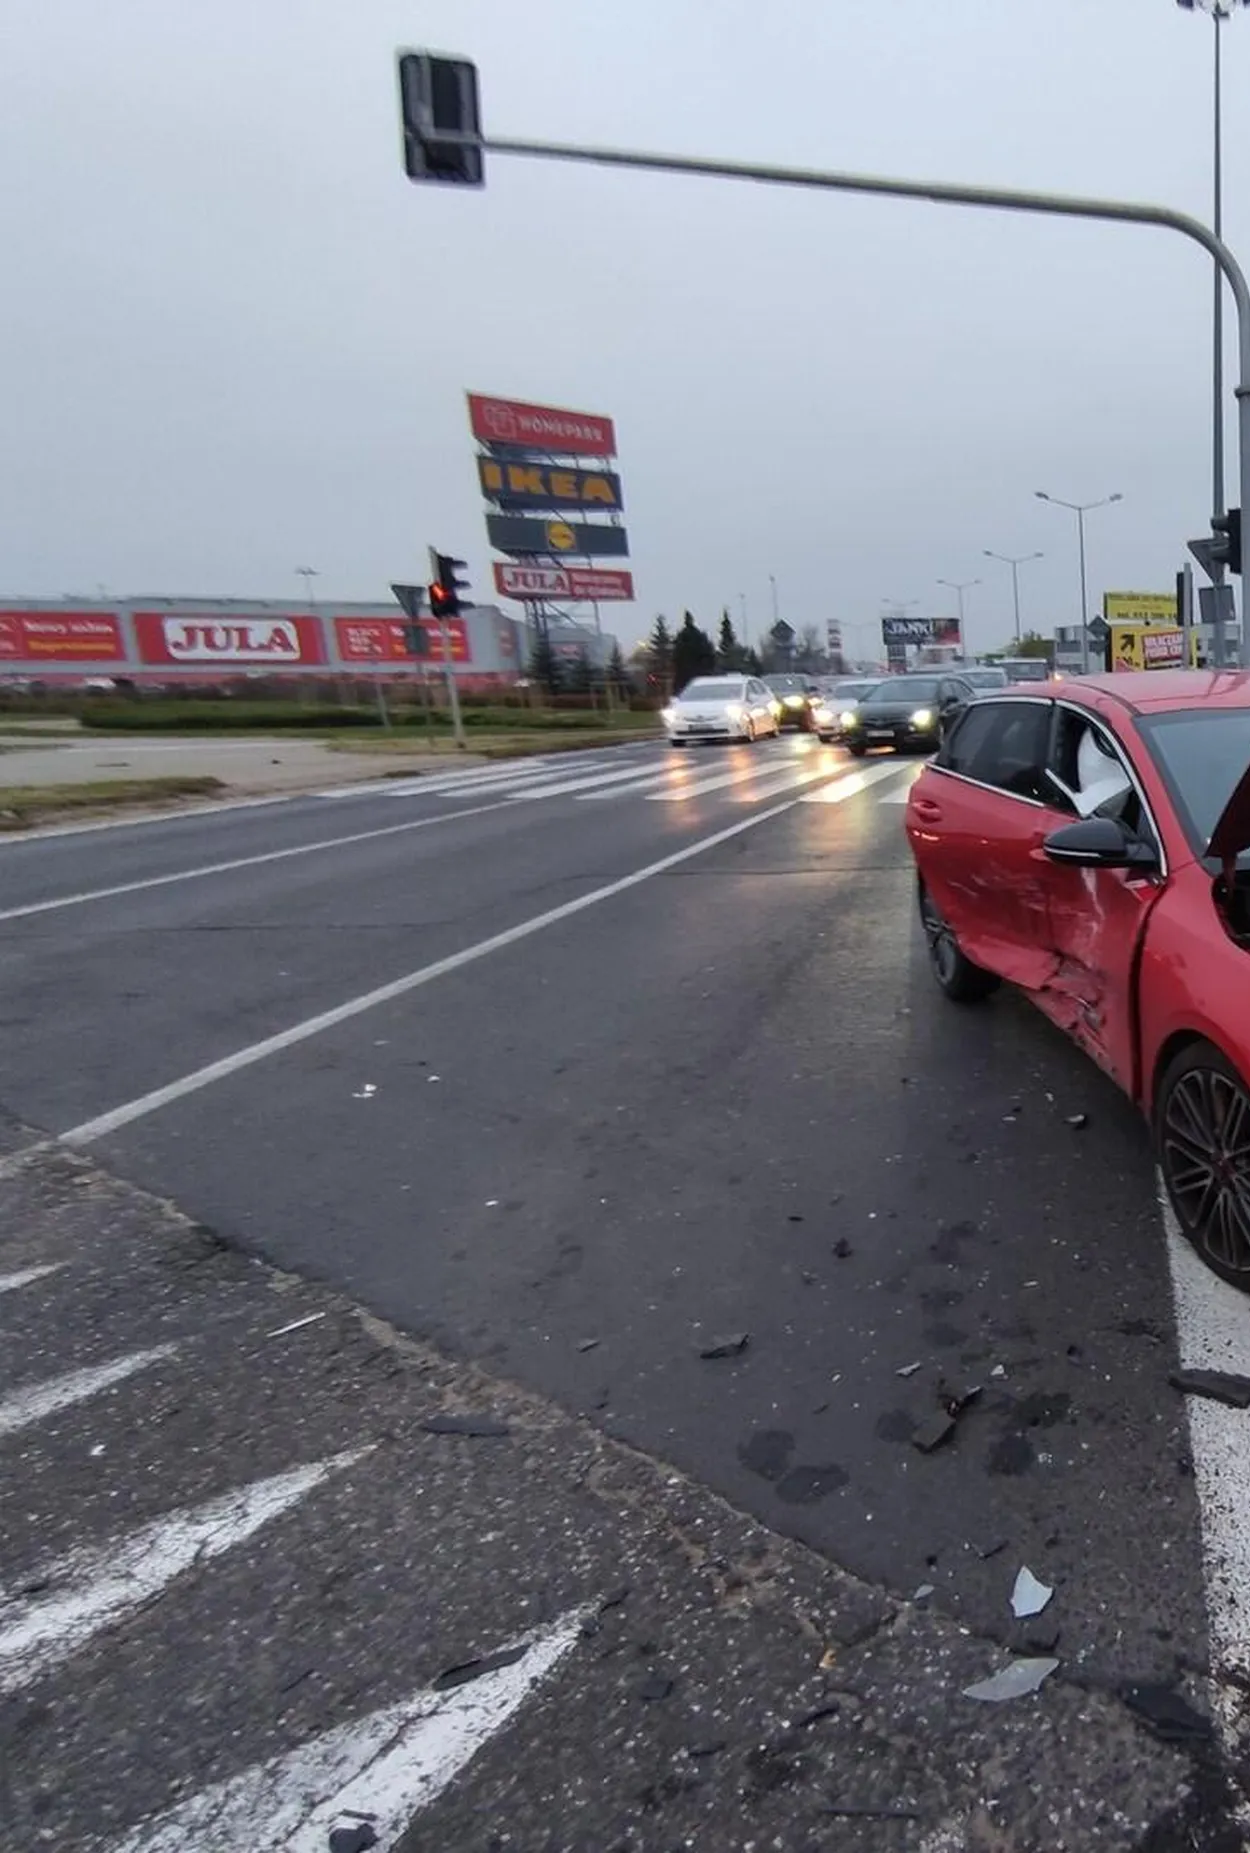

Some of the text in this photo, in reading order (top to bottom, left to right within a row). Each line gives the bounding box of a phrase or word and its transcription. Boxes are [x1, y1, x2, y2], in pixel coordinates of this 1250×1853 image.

[482, 460, 616, 505] IKEA
[507, 571, 566, 591] JULA
[170, 626, 298, 653] JULA
